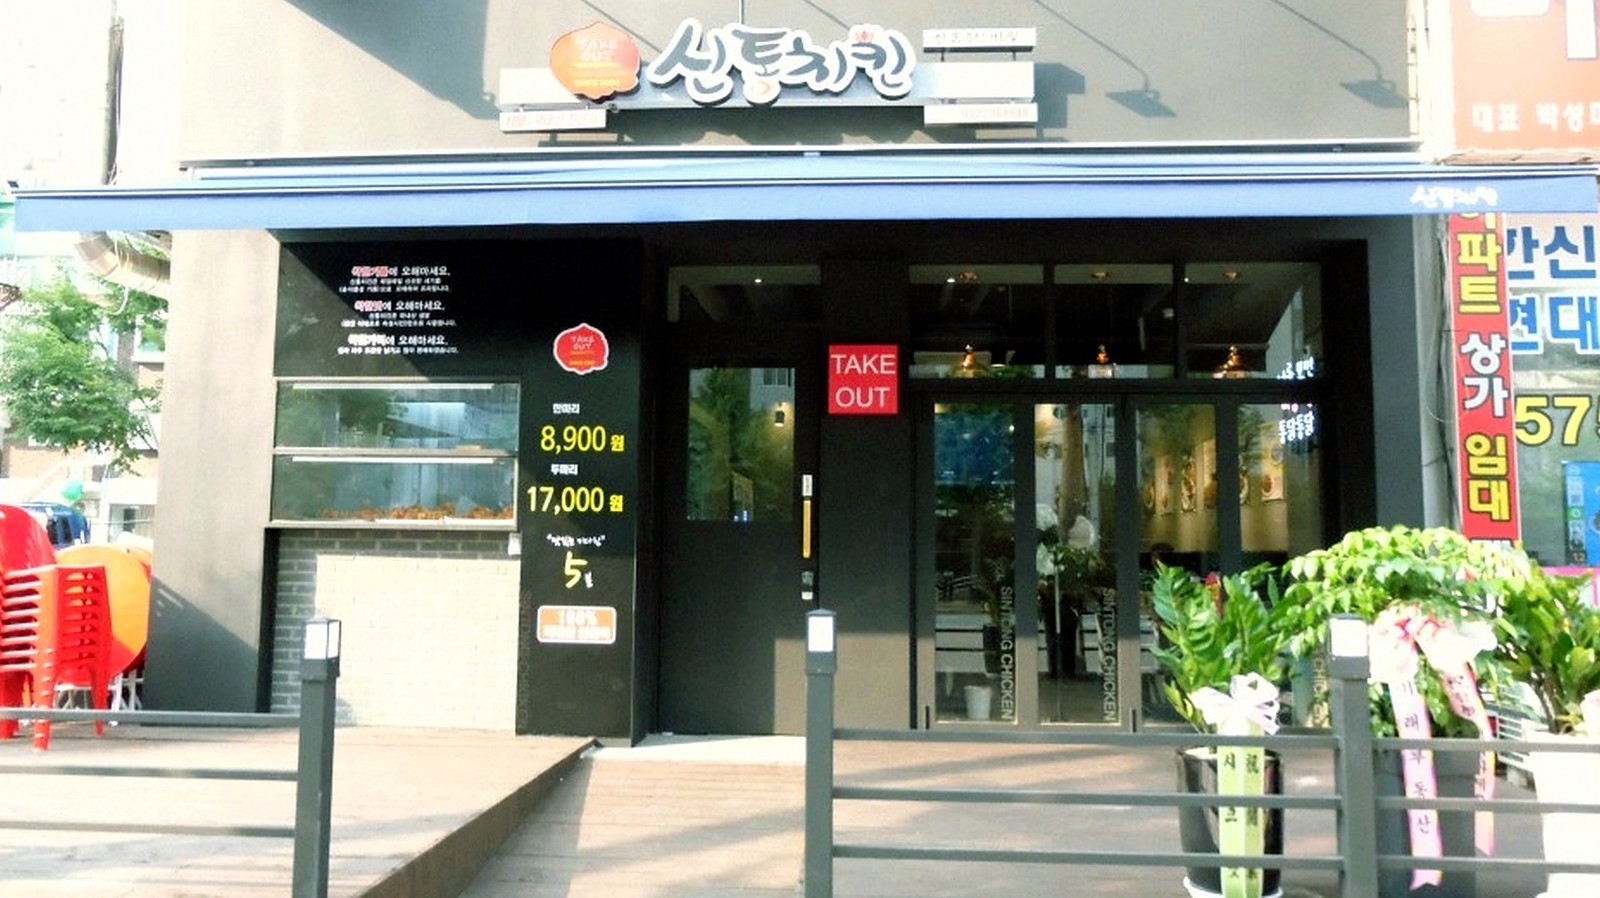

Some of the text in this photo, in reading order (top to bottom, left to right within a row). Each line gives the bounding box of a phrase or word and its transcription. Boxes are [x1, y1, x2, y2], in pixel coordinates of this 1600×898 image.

[649, 20, 914, 102] 신통치킨
[1472, 103, 1519, 132] 대표
[571, 335, 595, 343] TAKE
[830, 354, 896, 375] TAKE
[836, 386, 891, 408] OUT
[1461, 332, 1509, 417] 상가
[540, 425, 625, 455] 8,900 원
[1515, 395, 1600, 446] 57
[527, 486, 624, 515] 17,000 원
[1465, 432, 1511, 521] 임대
[1001, 586, 1013, 720] SINTONG CHICKEN
[1102, 587, 1116, 721] SINTONG CHICKEN
[1313, 657, 1325, 724] CHICEN
